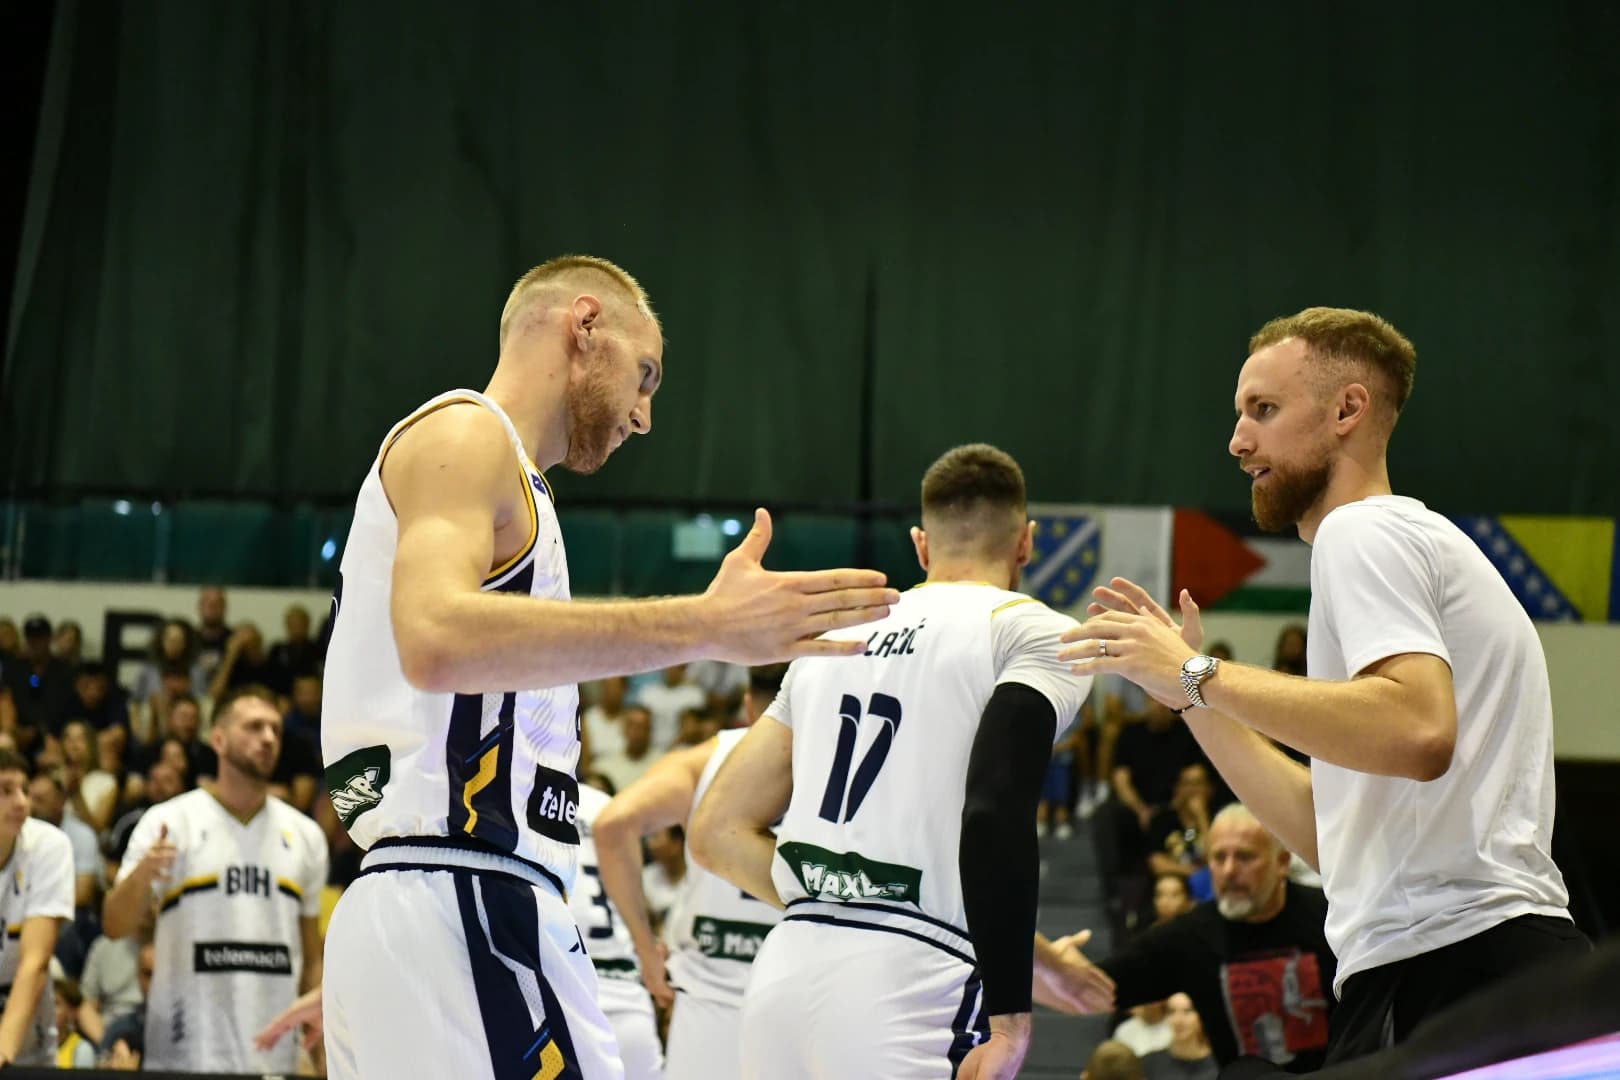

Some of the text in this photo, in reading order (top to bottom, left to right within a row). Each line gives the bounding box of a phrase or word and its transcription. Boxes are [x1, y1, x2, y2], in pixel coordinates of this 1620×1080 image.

[818, 692, 902, 825] 17
[226, 865, 270, 898] BIH
[800, 861, 908, 899] MAXT
